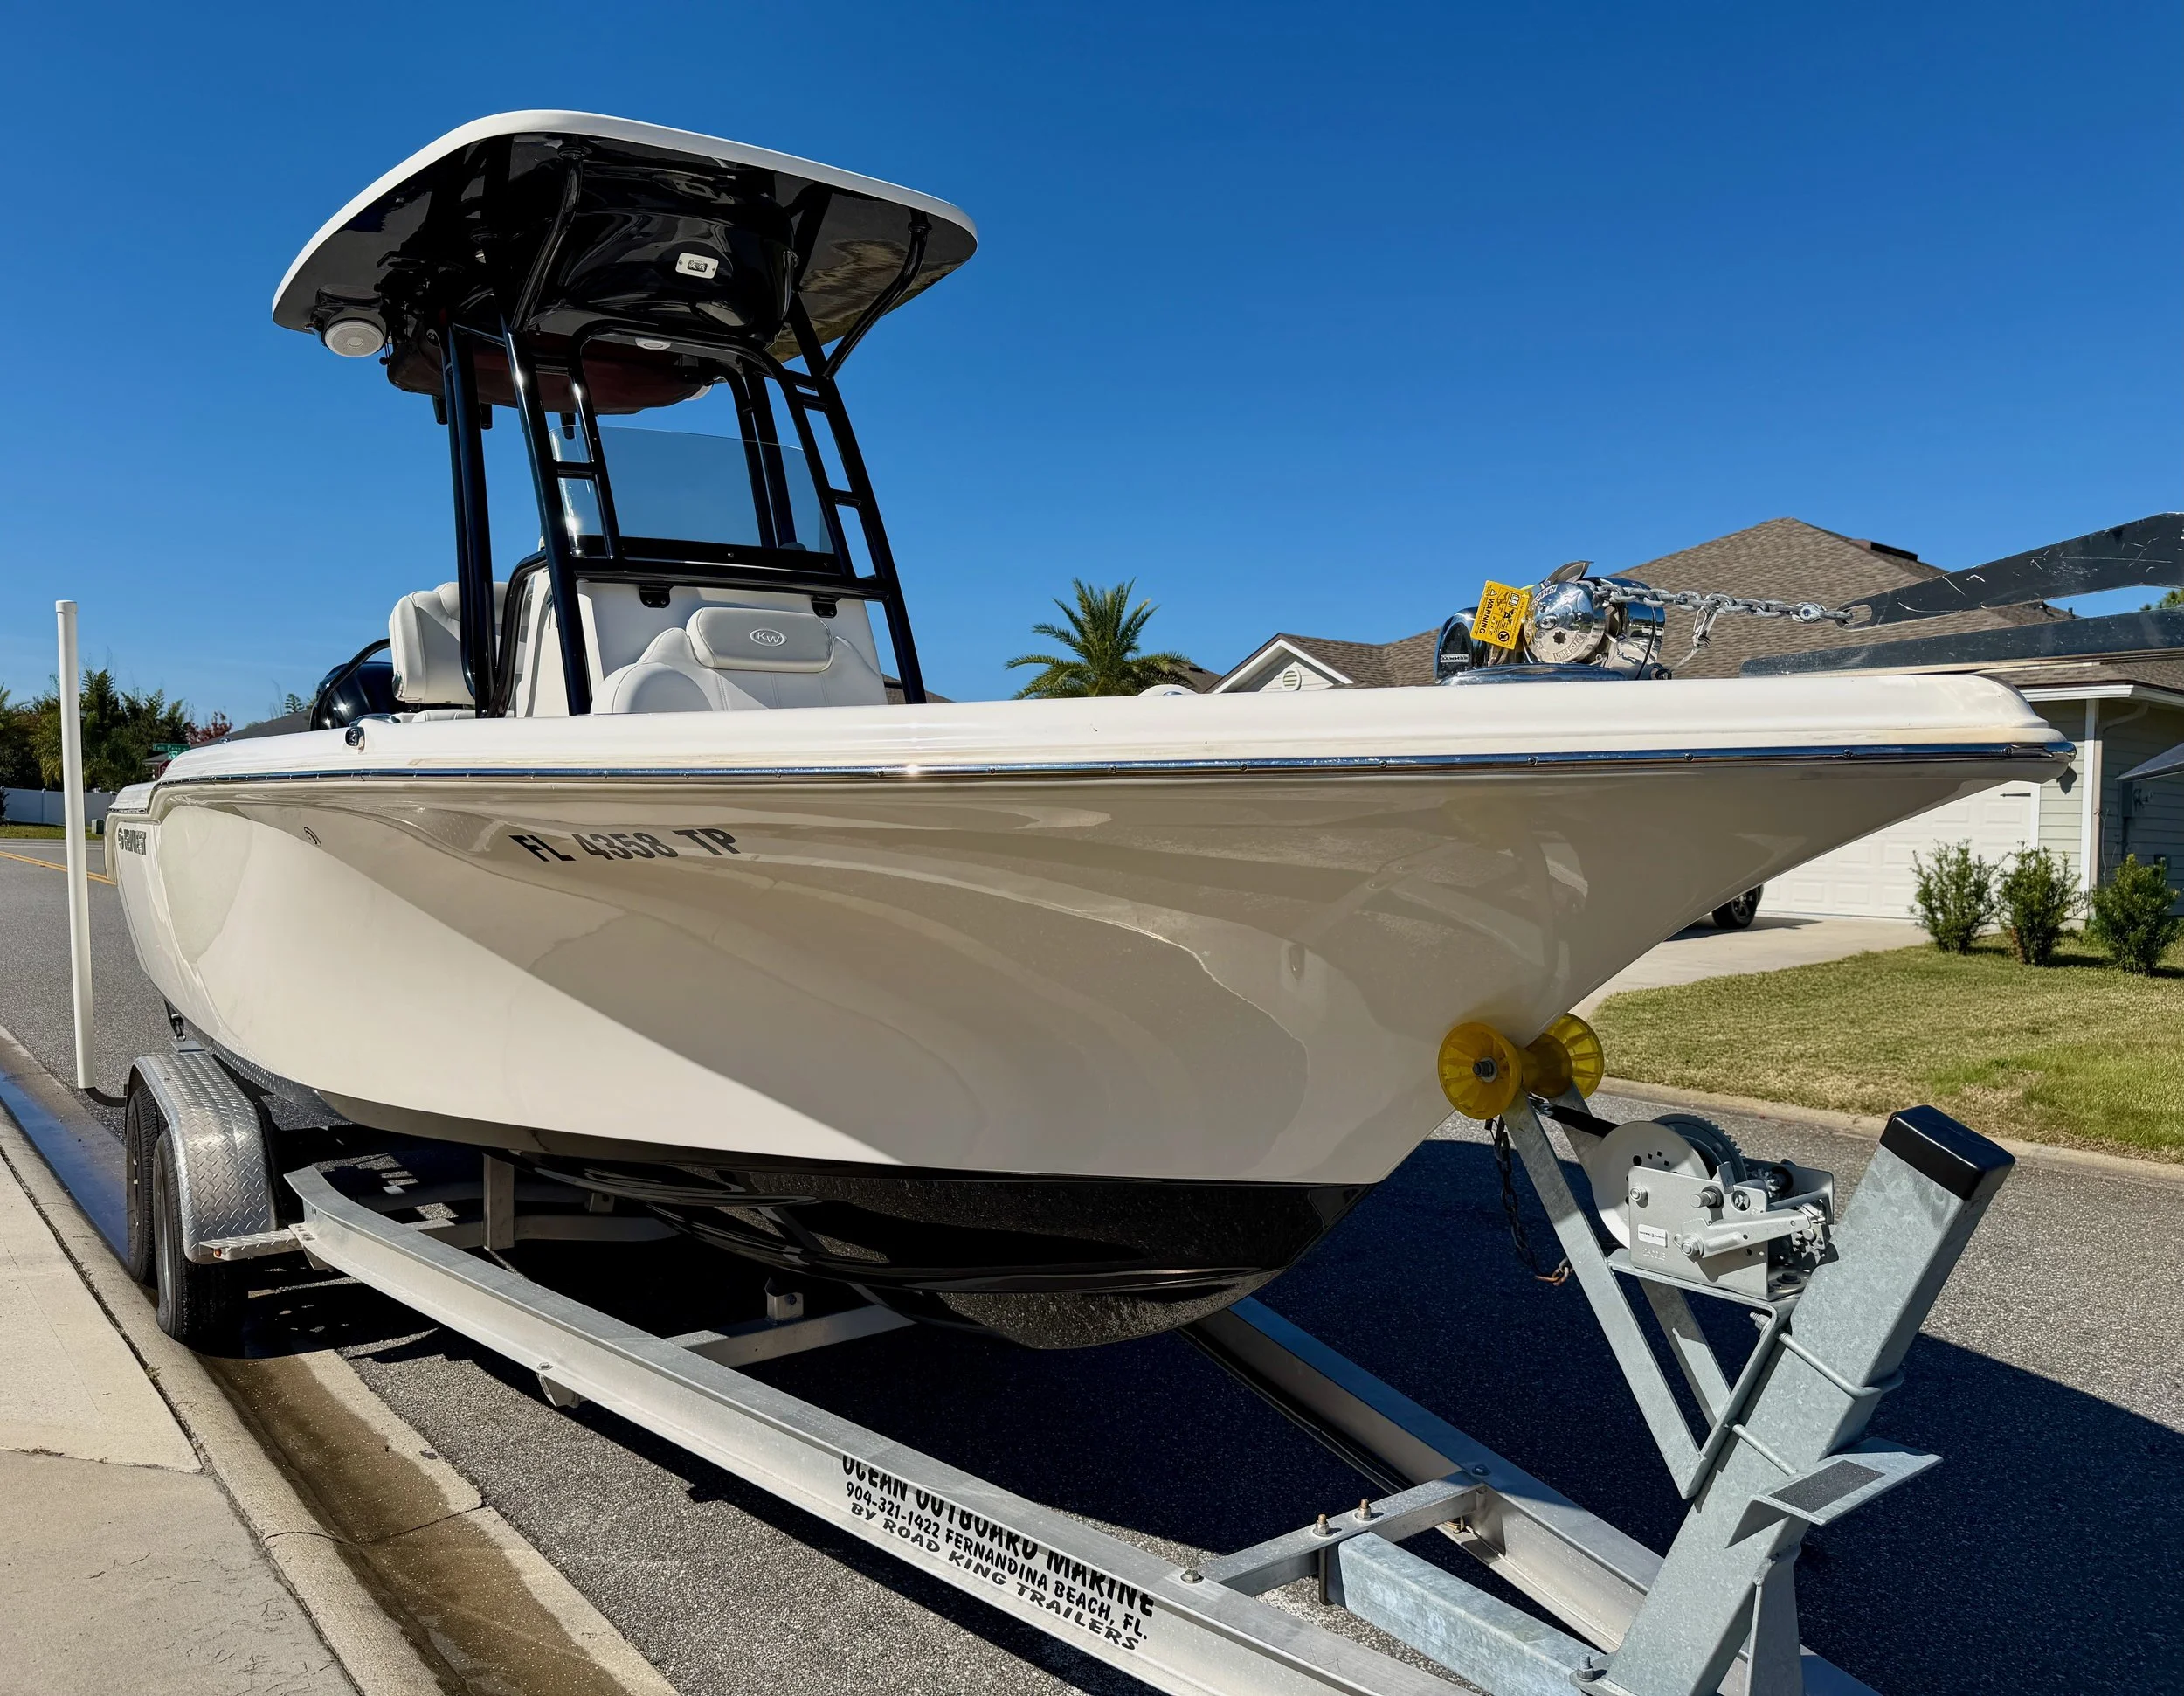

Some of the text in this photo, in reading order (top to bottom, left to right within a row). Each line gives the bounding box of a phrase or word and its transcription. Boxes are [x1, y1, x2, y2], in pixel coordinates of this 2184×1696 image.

[757, 631, 781, 643] KW
[1479, 599, 1495, 634] WARNING
[508, 828, 741, 862] FL 4358 TP
[842, 1455, 1155, 1617] OCEAN OUTBOARD MARINE
[846, 1481, 1148, 1640] 904-321-1422 FERNANDINA BEACH, FL.
[851, 1502, 1139, 1651] BY ROAD KING TRAILERS
